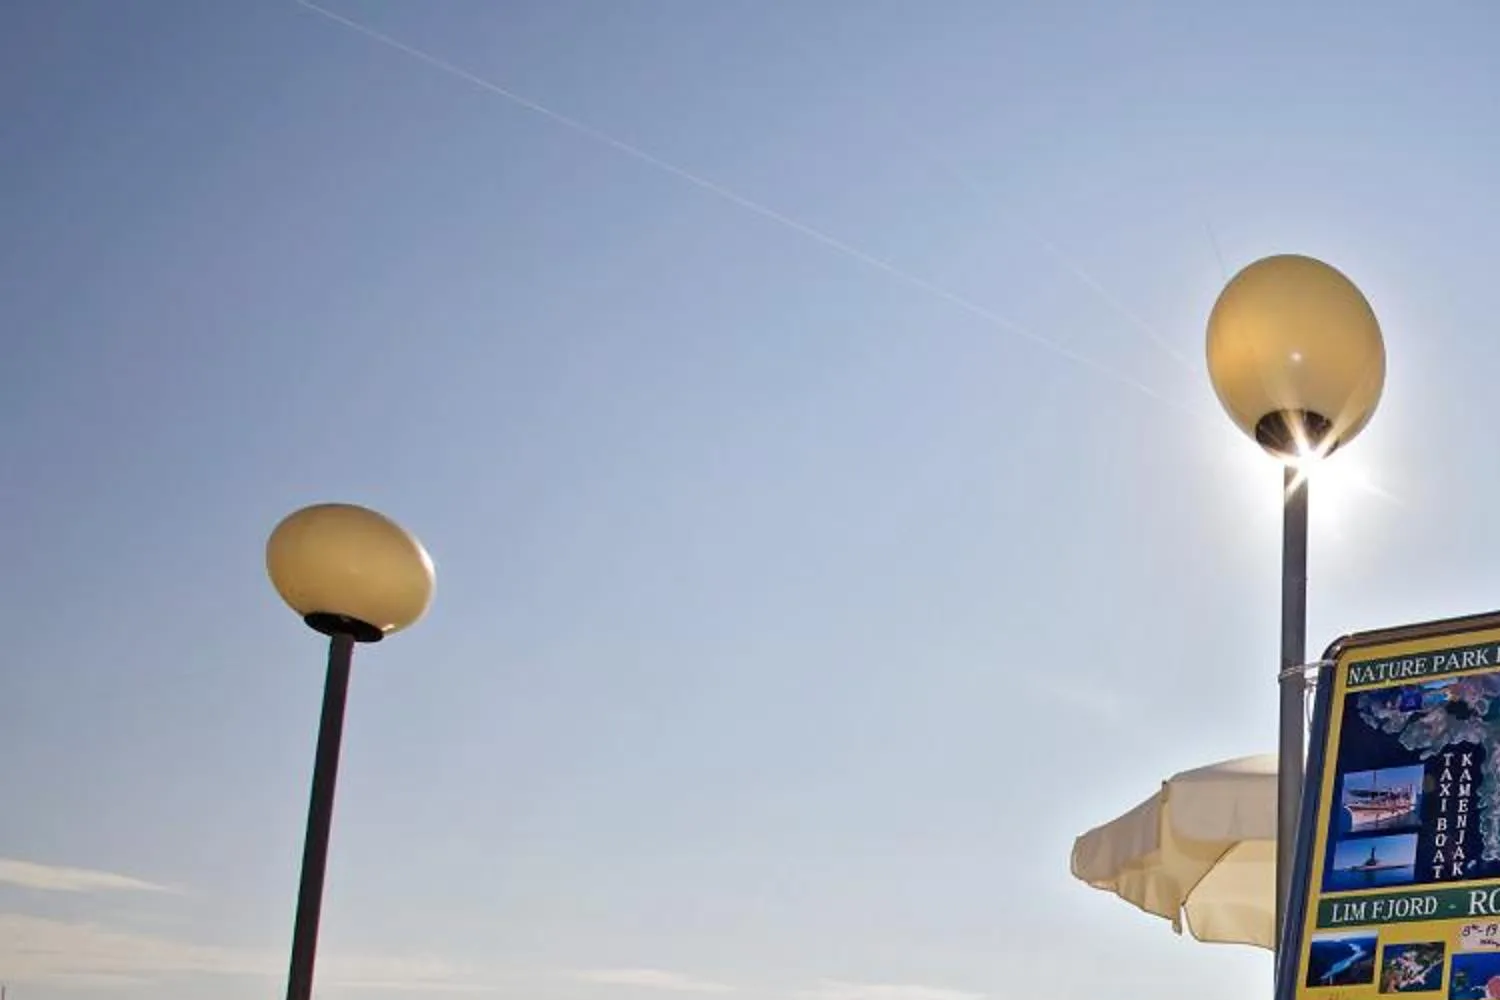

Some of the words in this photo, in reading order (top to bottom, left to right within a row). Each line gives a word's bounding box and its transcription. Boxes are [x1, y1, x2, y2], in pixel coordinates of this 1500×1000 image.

[1347, 657, 1427, 685] NATURE
[1433, 650, 1490, 675] PARK
[1440, 753, 1455, 813] TAXI
[1452, 752, 1473, 877] KAMENJAK
[1432, 817, 1448, 878] BOAT
[1331, 901, 1366, 923] LIM
[1372, 896, 1438, 921] FJORD
